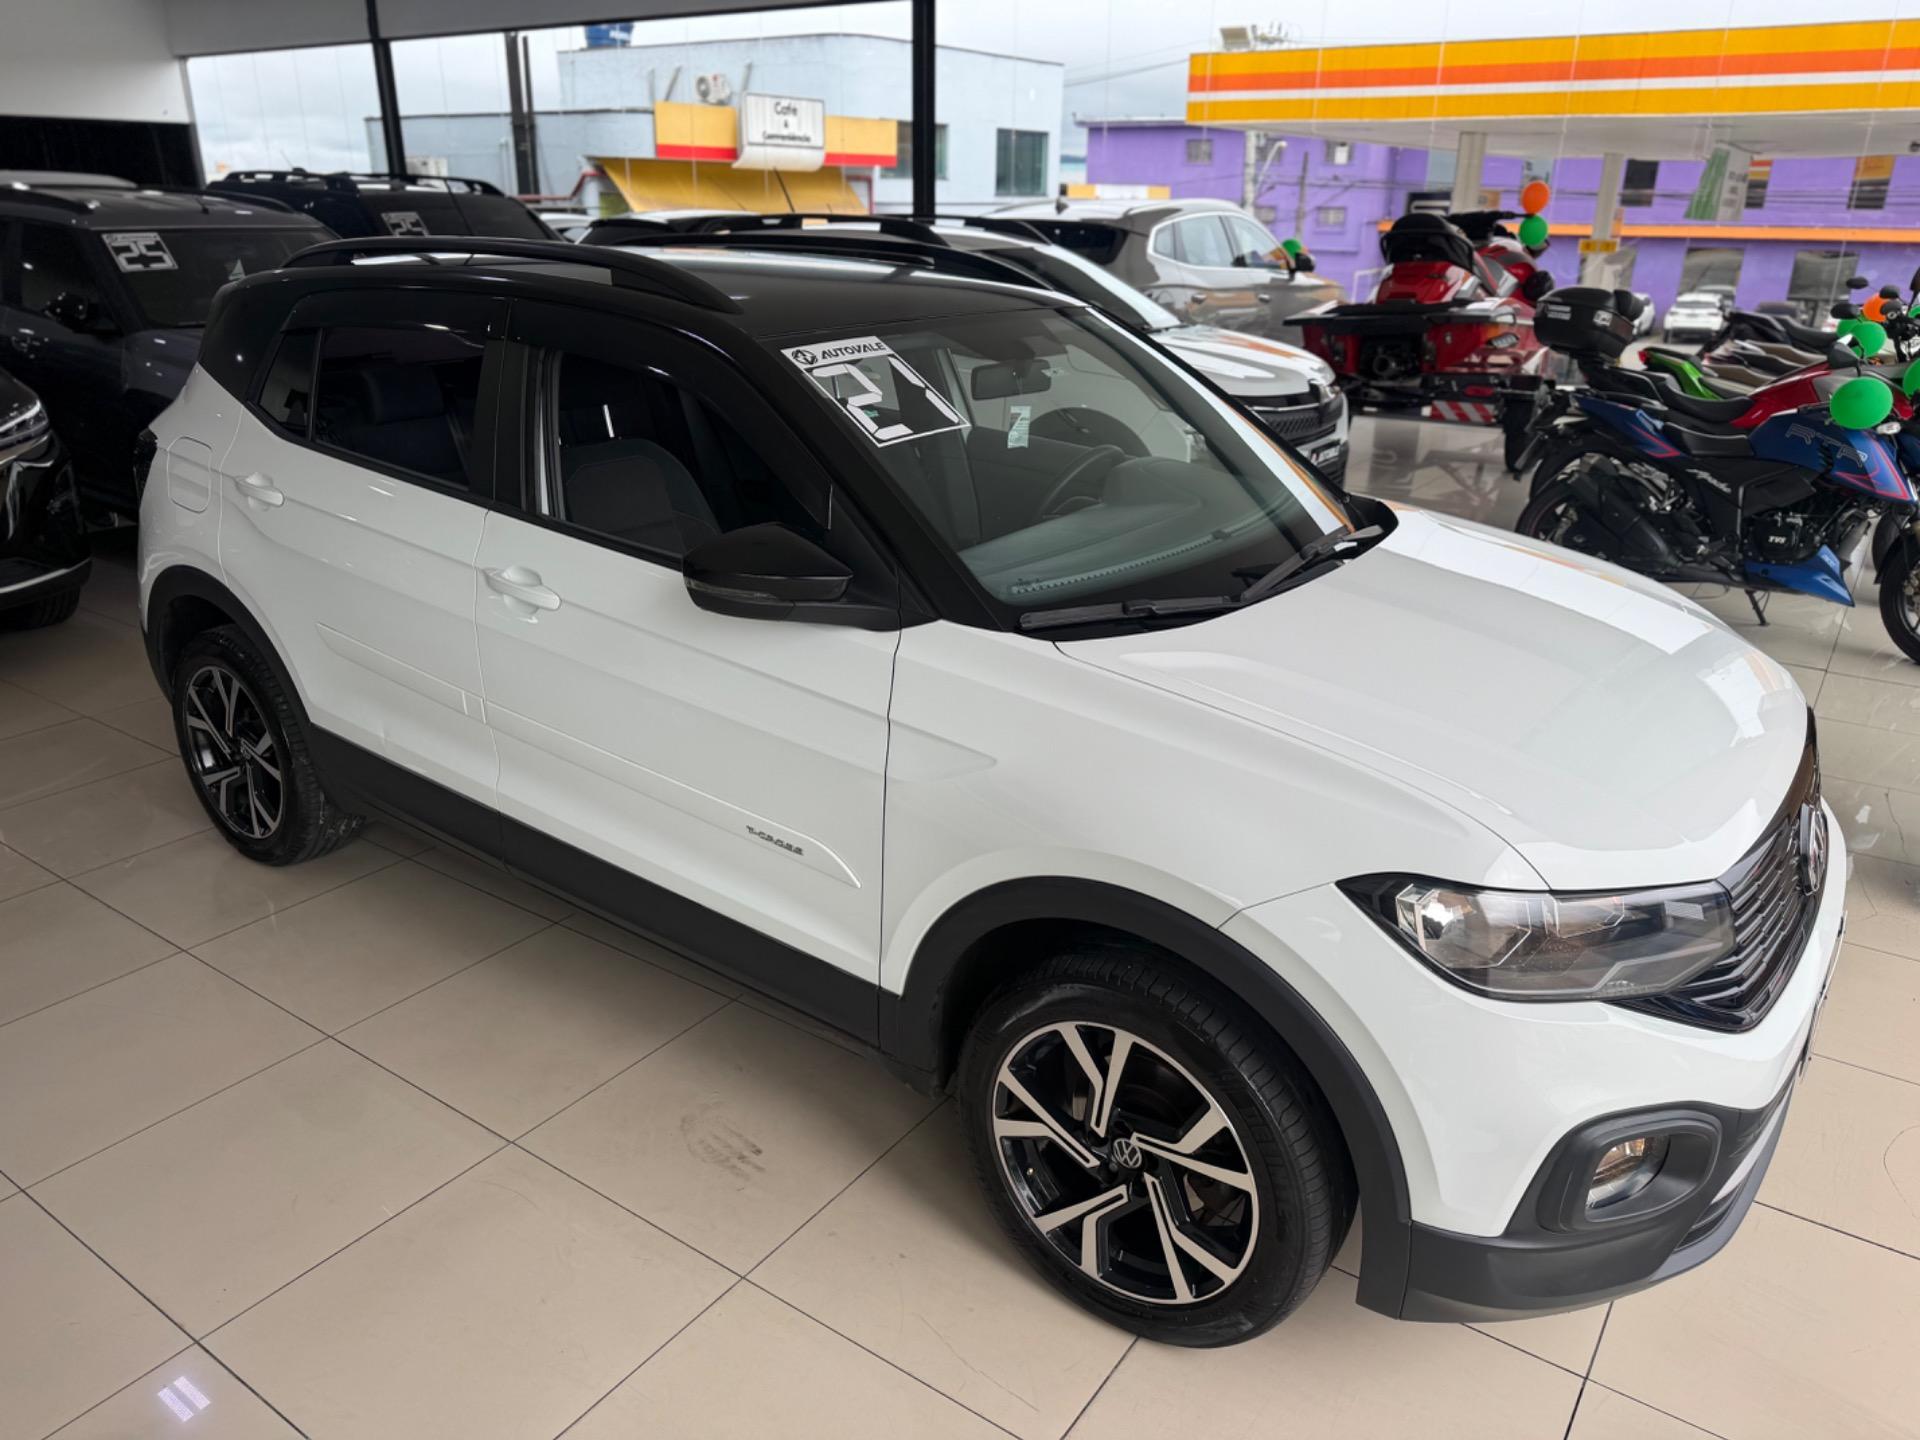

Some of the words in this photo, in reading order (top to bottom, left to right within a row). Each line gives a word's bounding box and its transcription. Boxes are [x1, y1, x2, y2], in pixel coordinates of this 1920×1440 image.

[110, 240, 173, 270] 25
[821, 342, 887, 360] AUTOVALE
[811, 356, 960, 441] 21
